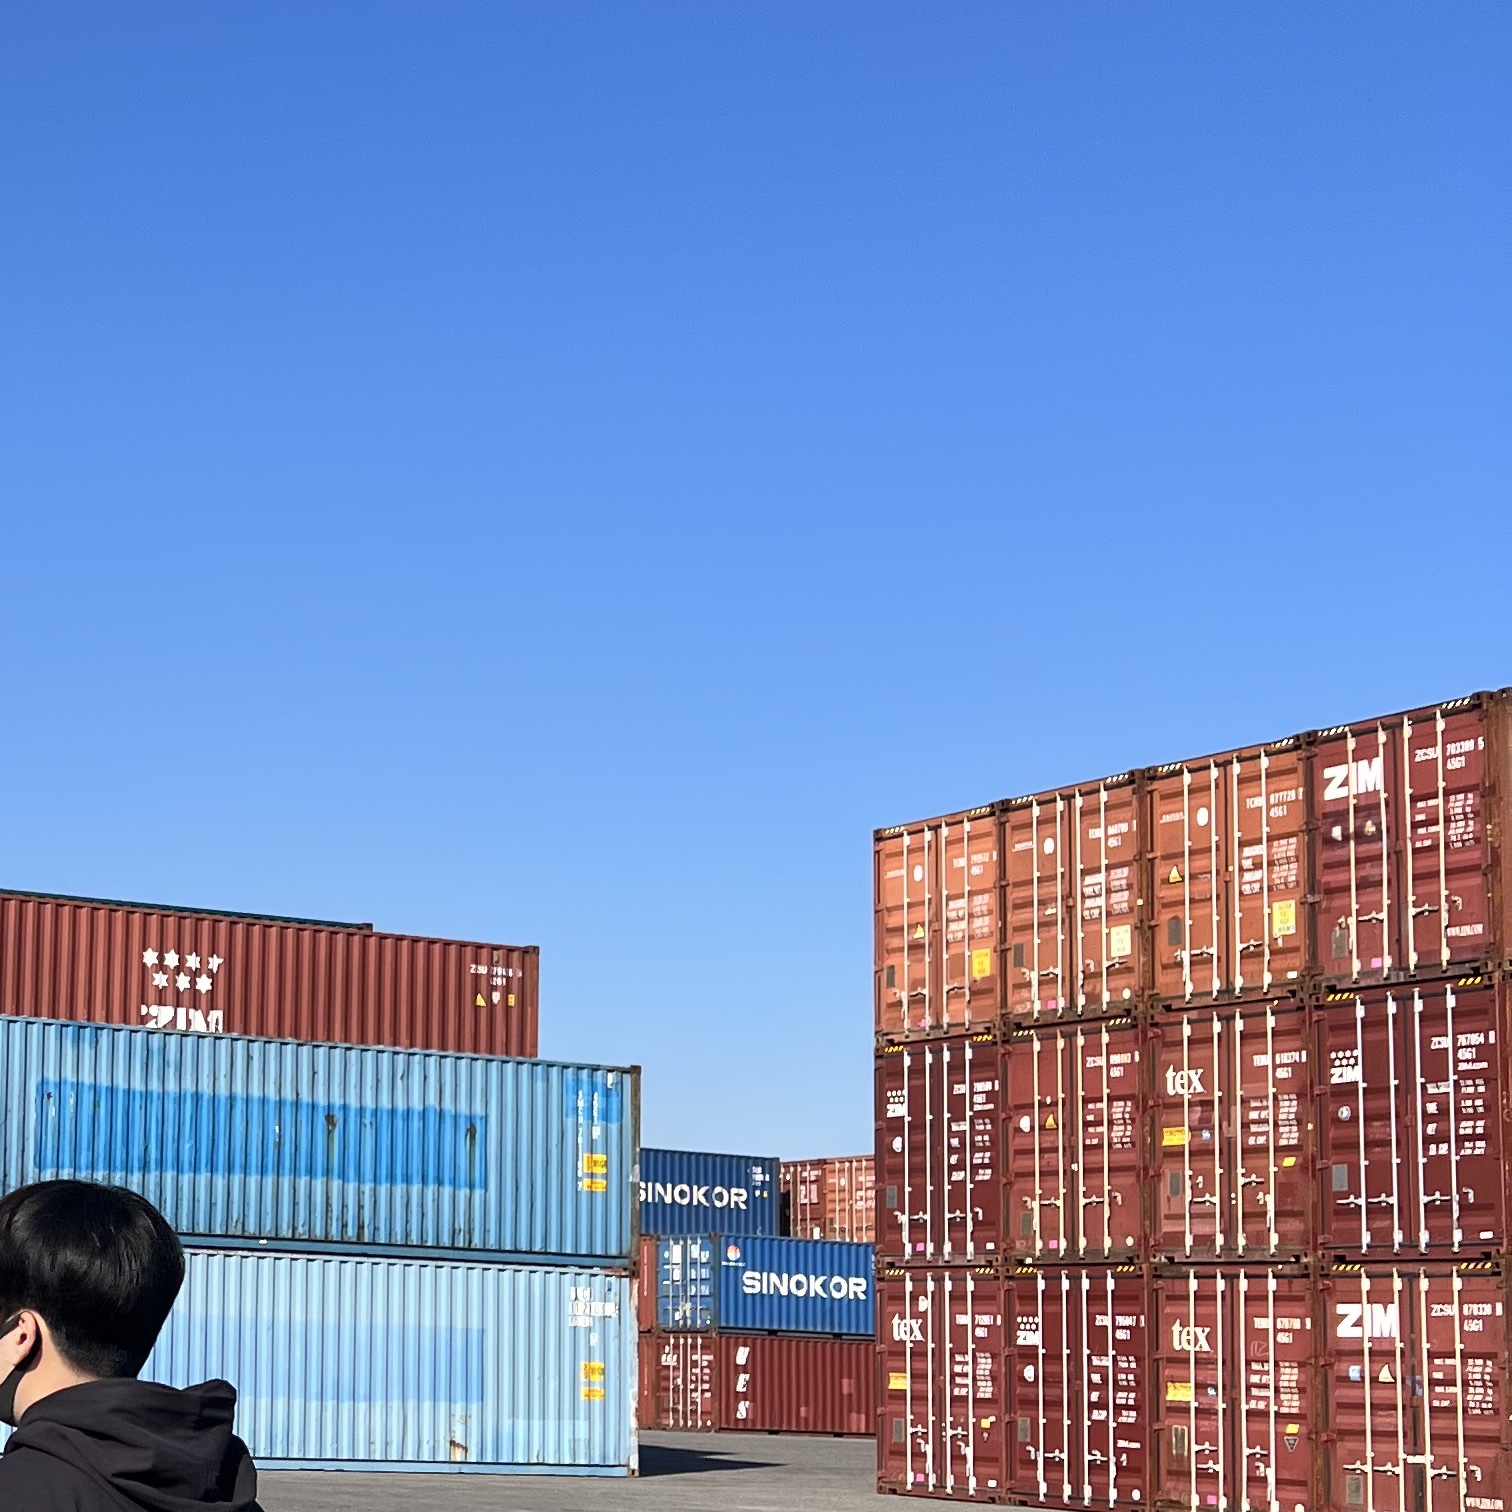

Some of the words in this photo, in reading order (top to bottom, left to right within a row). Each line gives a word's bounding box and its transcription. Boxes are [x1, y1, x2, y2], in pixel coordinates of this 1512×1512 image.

[1323, 757, 1381, 801] ZIM
[1165, 1064, 1206, 1096] tex
[1330, 1066, 1360, 1084] ZIM
[742, 1270, 867, 1300] SINOKOR
[891, 1312, 925, 1343] tex
[1171, 1318, 1211, 1352] tex
[1336, 1303, 1399, 1338] ZIM
